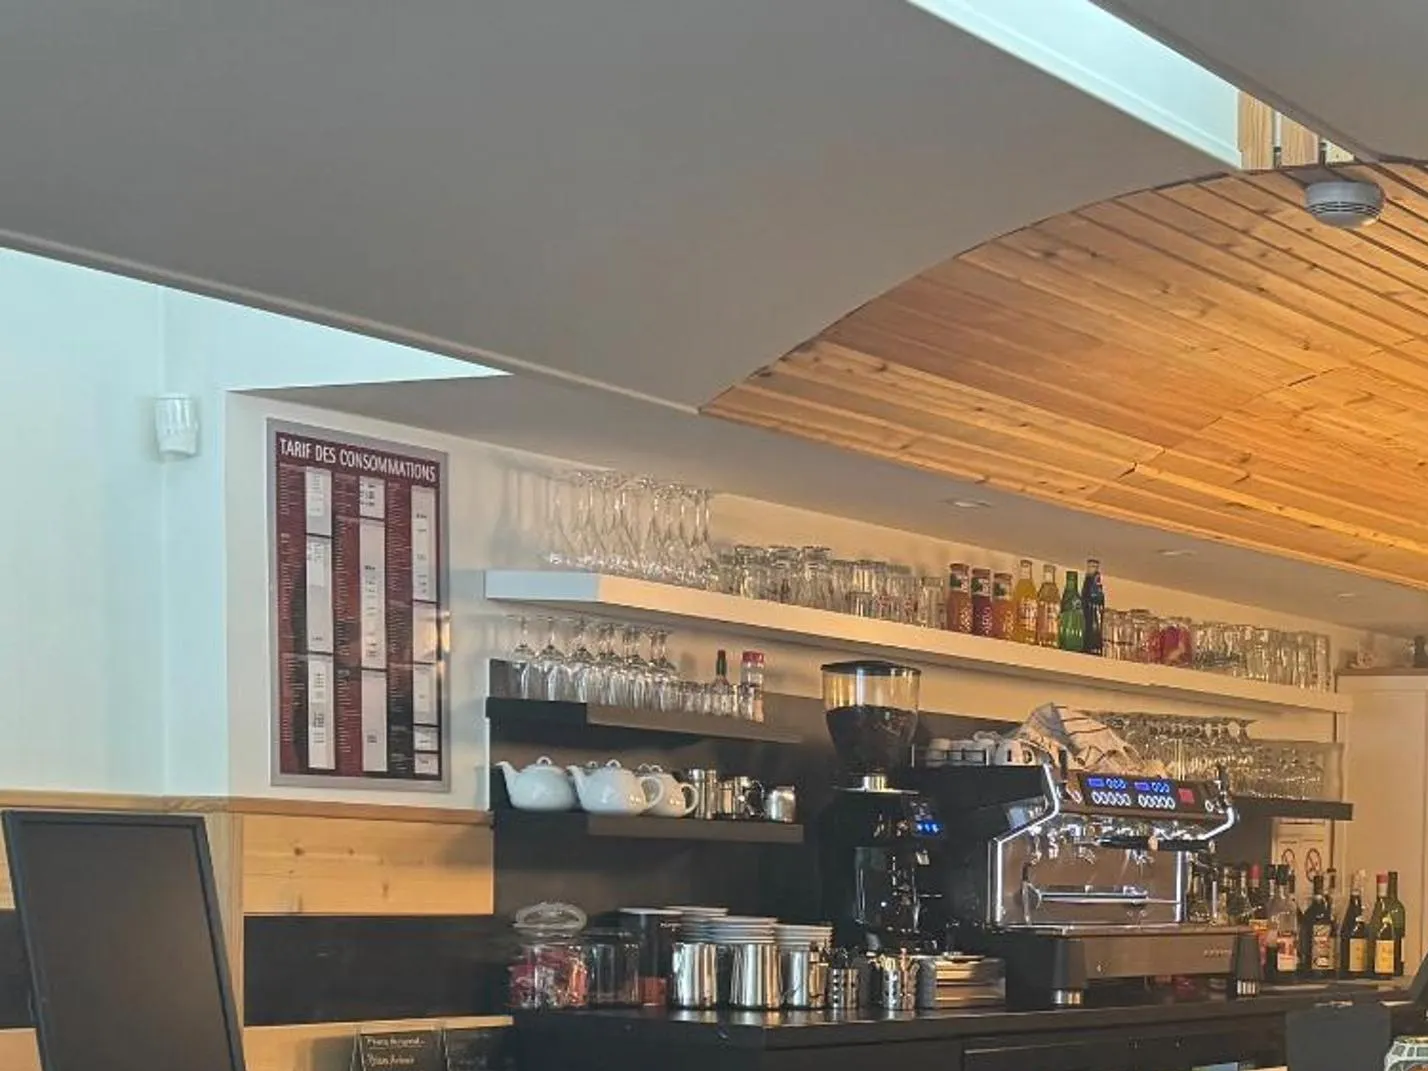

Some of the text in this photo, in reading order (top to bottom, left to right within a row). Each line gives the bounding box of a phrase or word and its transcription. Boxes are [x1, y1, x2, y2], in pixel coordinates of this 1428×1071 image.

[280, 437, 436, 483] TARIF DES CONSOMMATIONS
